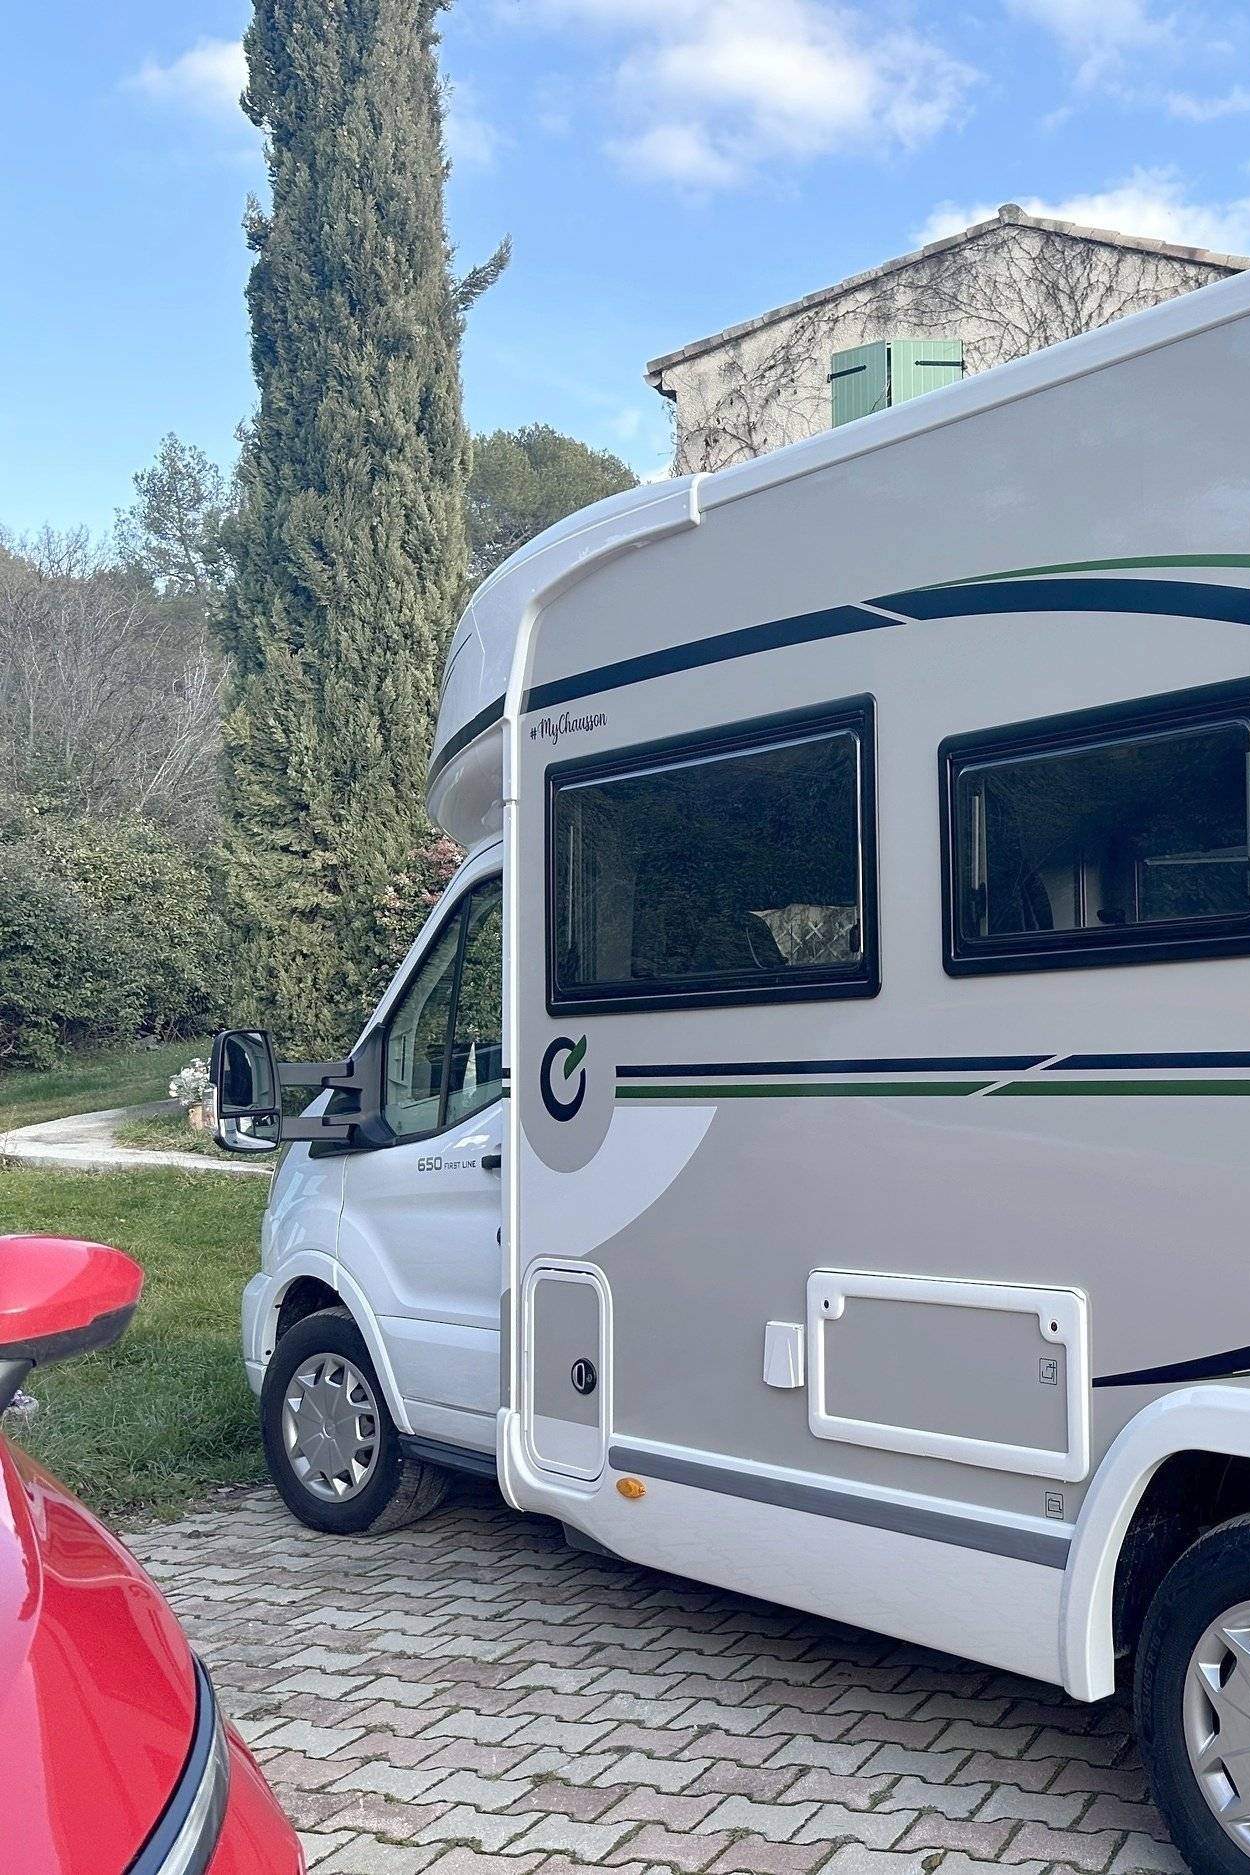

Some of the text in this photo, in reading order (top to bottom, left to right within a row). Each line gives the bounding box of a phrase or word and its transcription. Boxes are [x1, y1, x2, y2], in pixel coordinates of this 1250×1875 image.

[529, 711, 608, 746] #MyChausson
[417, 1156, 477, 1172] 650 FIRST LINE
